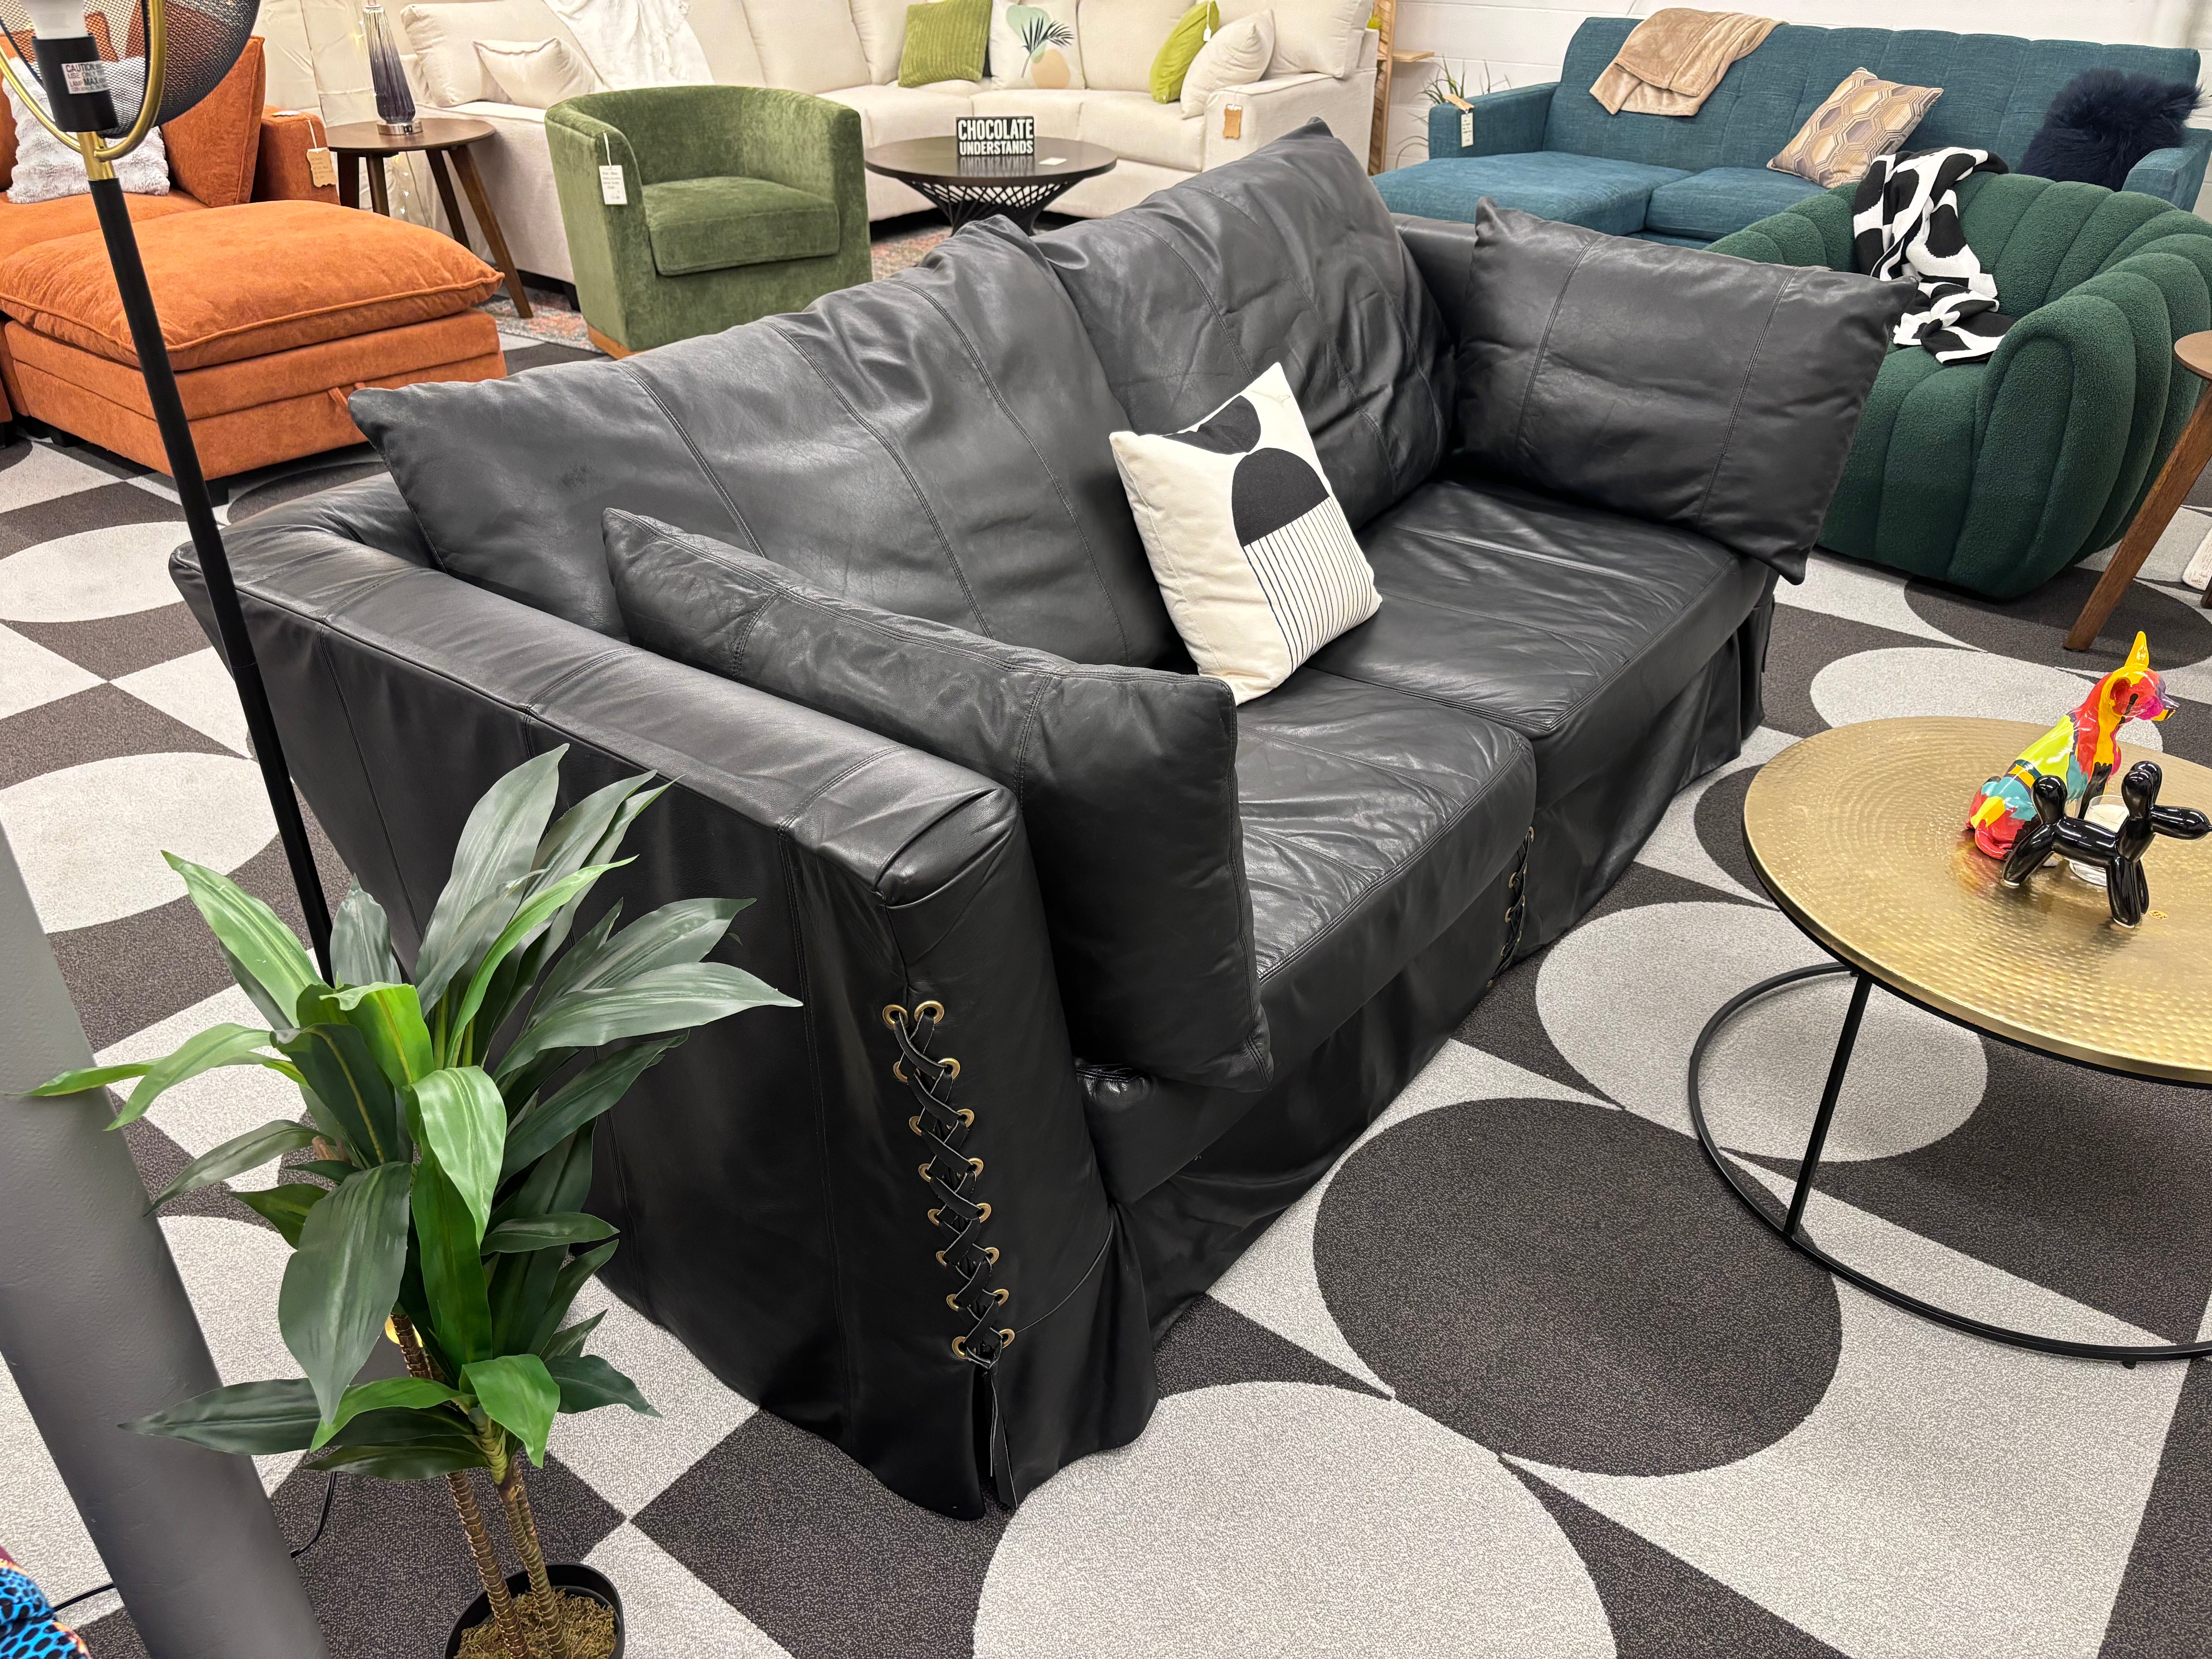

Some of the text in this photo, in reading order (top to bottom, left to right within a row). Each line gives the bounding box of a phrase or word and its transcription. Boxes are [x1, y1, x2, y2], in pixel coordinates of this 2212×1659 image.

[83, 77, 99, 86] MAX
[958, 119, 1034, 141] CHOCOLATE
[959, 140, 1033, 155] UNDERSTANDS
